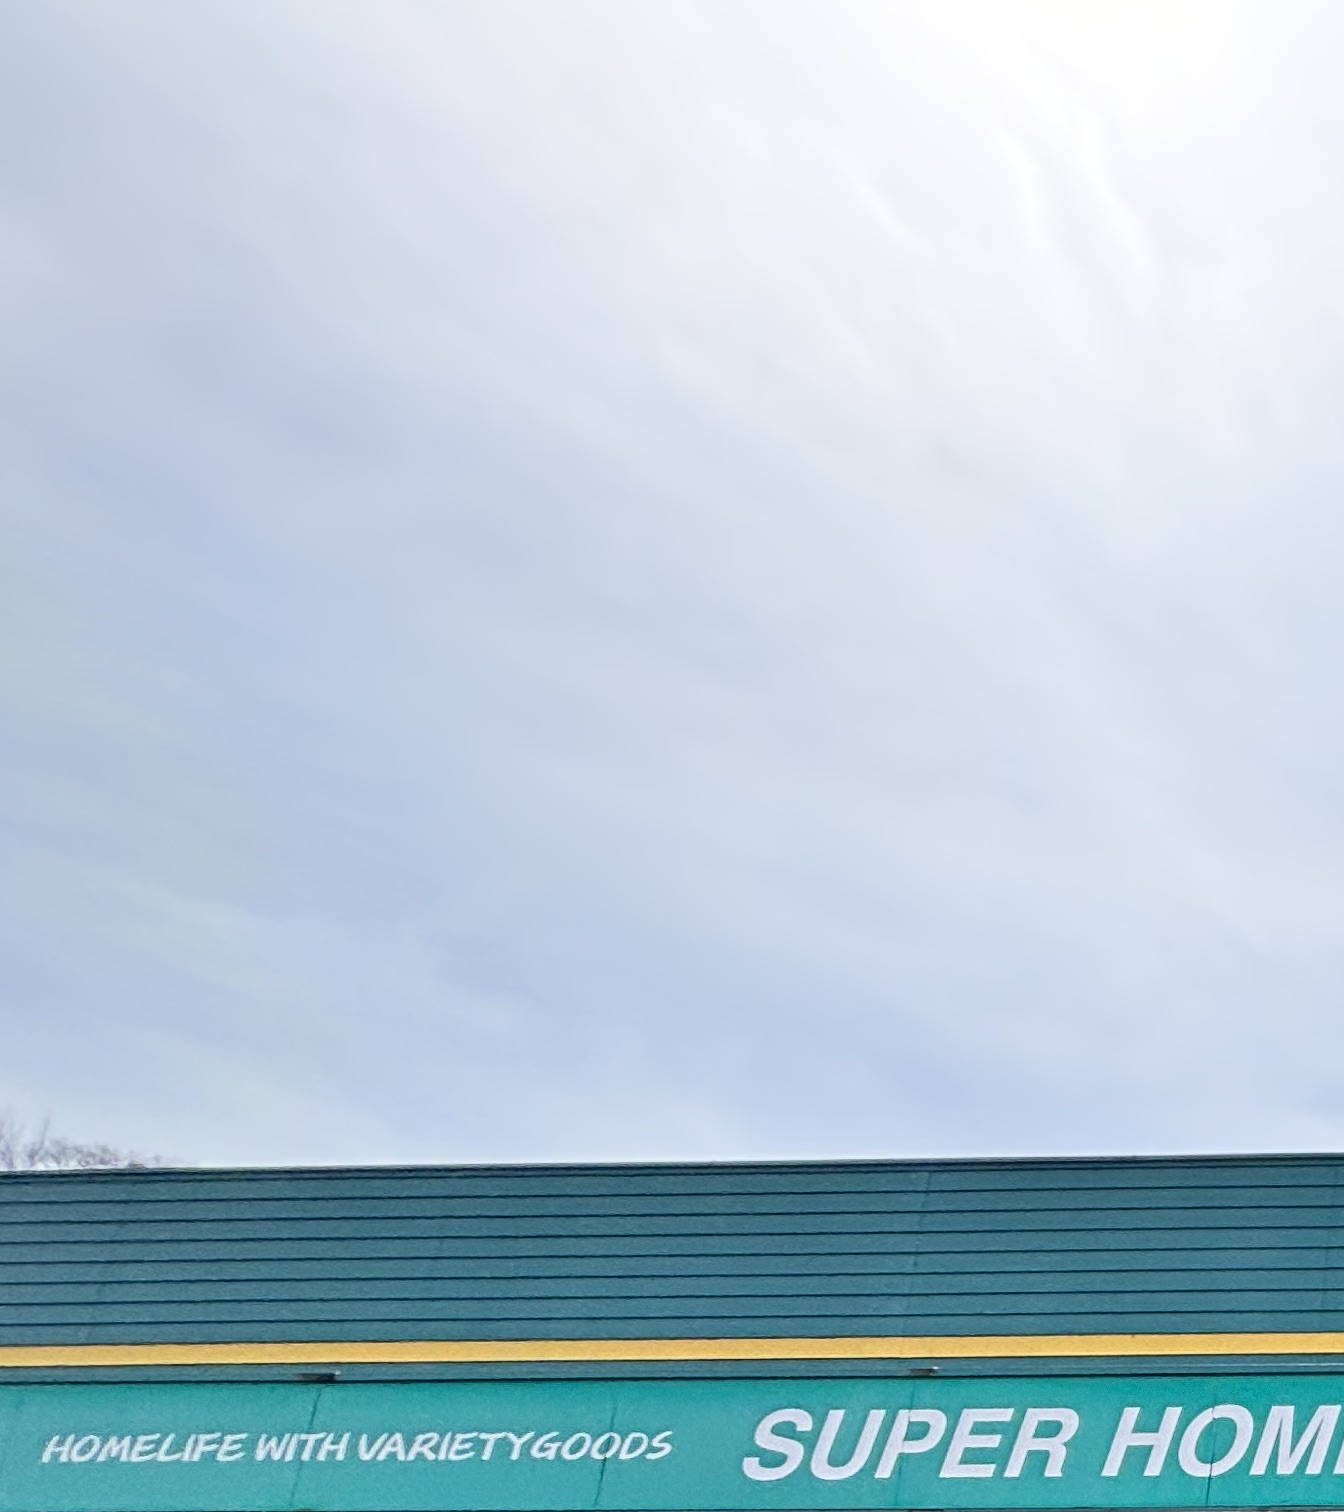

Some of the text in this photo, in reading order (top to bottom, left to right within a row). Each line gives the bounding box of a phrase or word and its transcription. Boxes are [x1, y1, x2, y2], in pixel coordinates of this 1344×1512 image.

[42, 1433, 247, 1463] HOMELIFE
[255, 1432, 350, 1462] WITH
[743, 1407, 1079, 1481] SUPER
